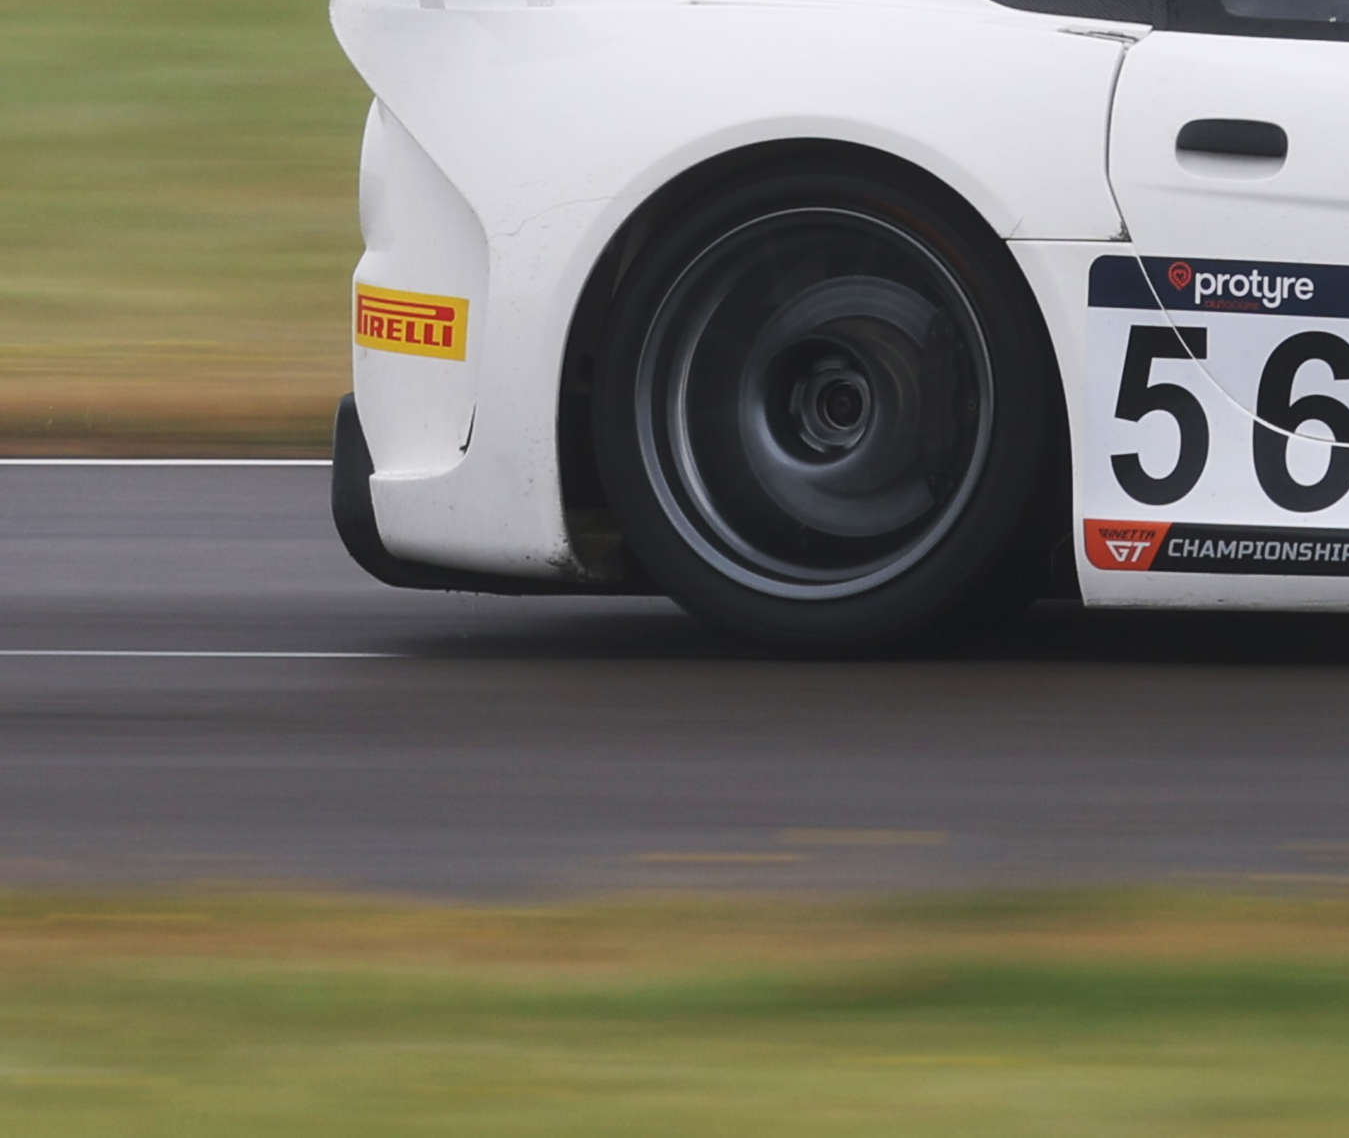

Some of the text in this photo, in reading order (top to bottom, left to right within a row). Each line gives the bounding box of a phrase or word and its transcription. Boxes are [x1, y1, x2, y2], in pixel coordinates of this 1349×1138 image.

[1195, 269, 1314, 308] protyre
[357, 293, 455, 347] PIRELLI
[1105, 540, 1151, 563] GT
